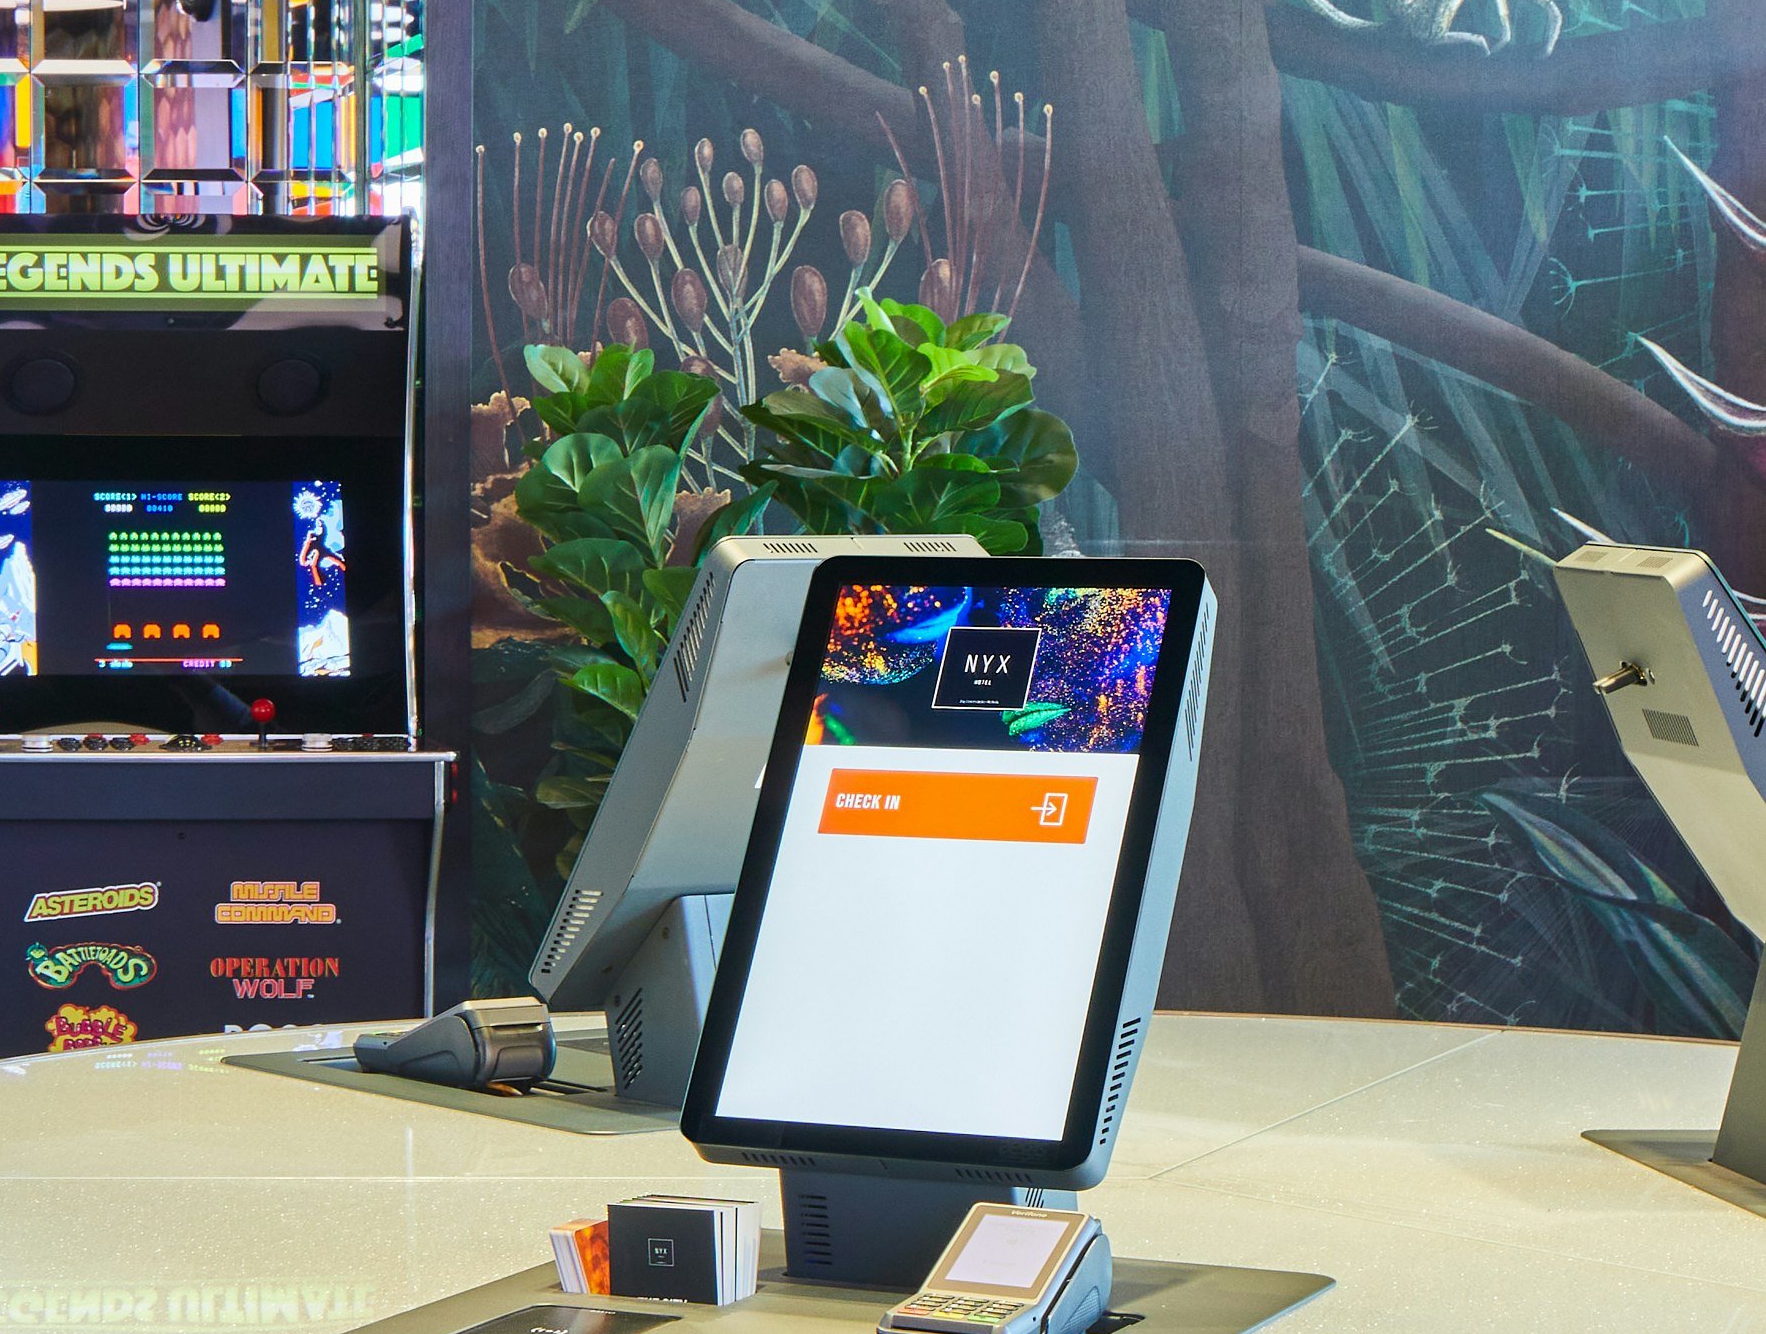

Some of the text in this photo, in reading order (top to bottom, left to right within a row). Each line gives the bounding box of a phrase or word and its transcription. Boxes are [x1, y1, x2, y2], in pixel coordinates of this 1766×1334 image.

[168, 252, 378, 292] ULTIMATE
[93, 492, 232, 502] SCORE<1> HI-SCORE SCORE<2>
[964, 654, 1011, 674] NYX
[835, 792, 901, 811] CHECK IN
[30, 886, 155, 918] ASTEROIDS
[232, 883, 318, 900] MISSILE
[217, 905, 334, 923] COMMAND
[35, 945, 149, 983] BATTLETOADS
[210, 956, 340, 978] OPERATION
[233, 978, 315, 999] WOLF
[55, 1016, 127, 1043] BUBBLE
